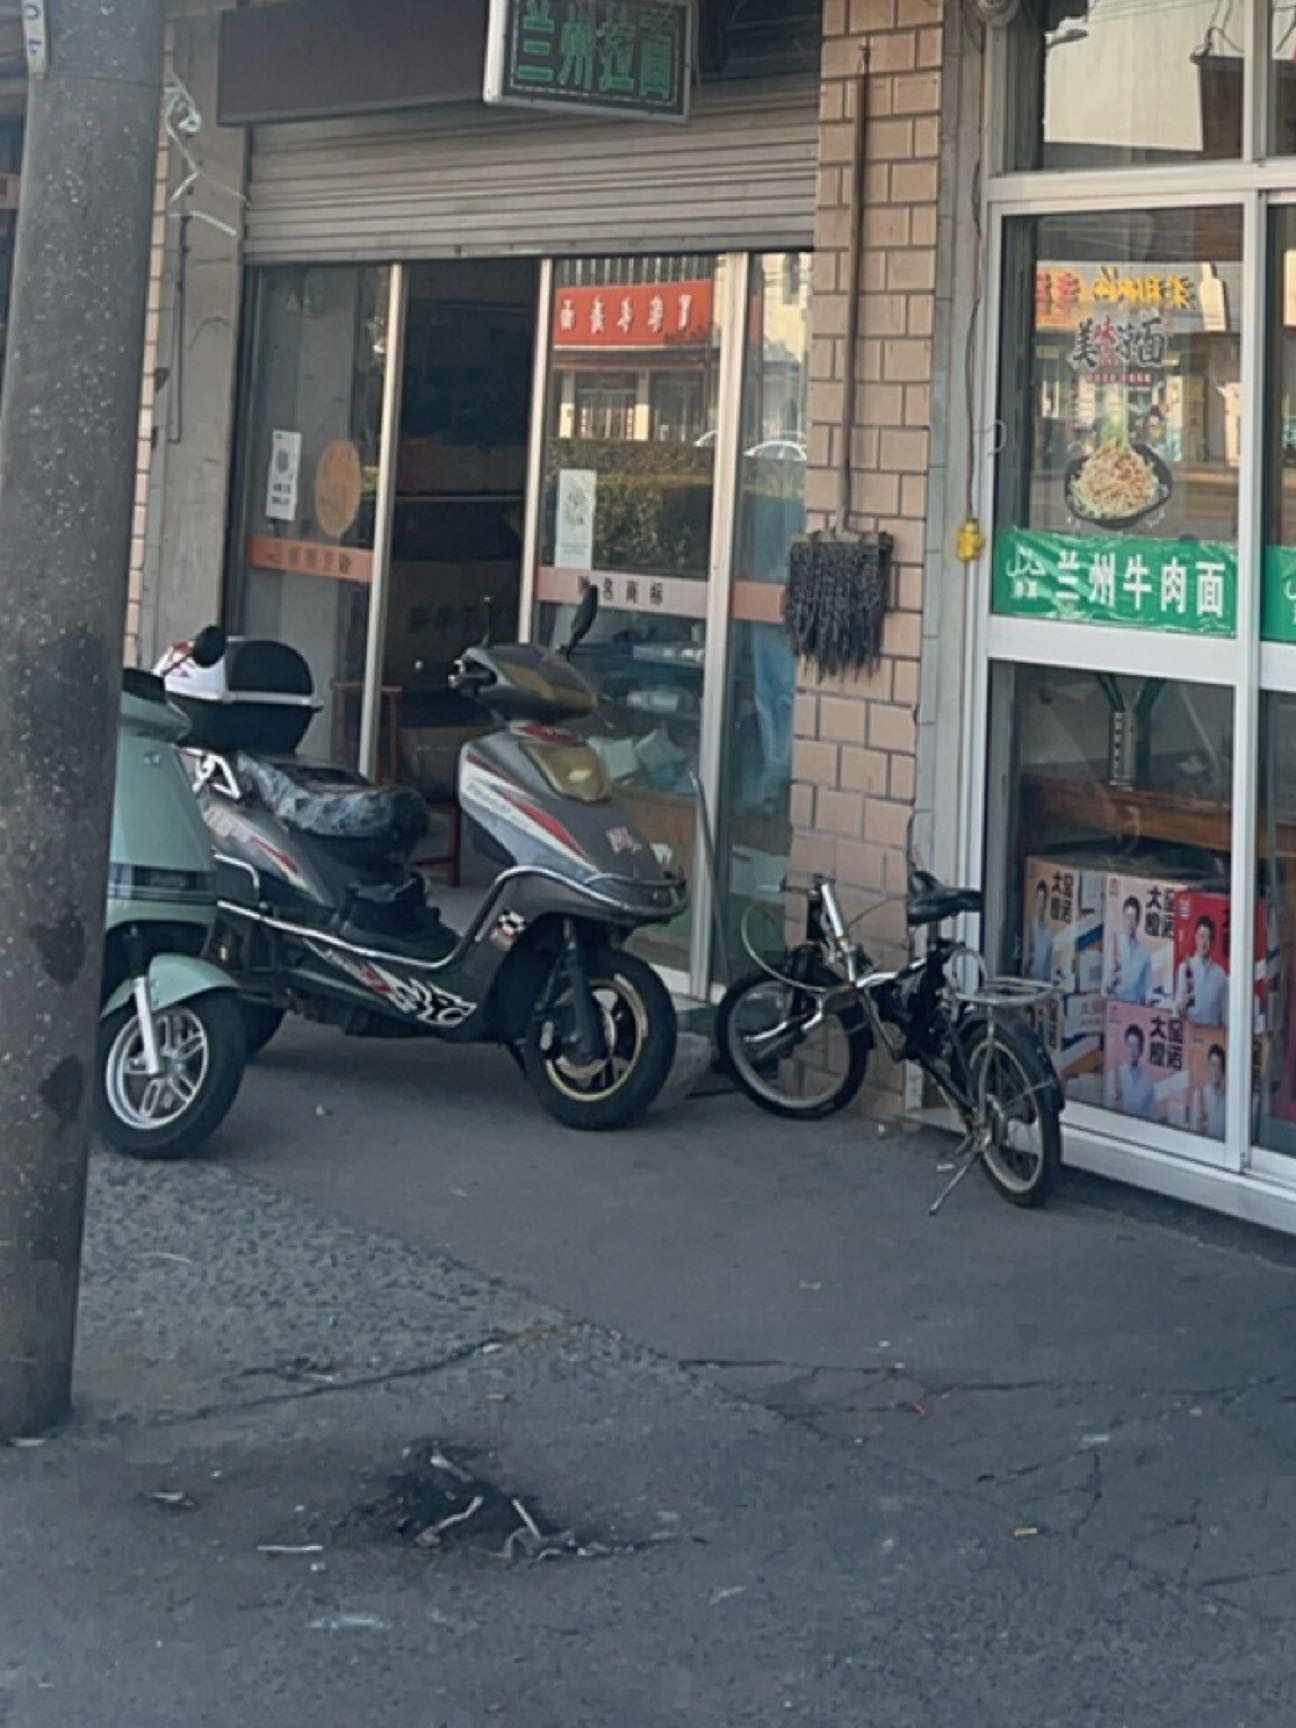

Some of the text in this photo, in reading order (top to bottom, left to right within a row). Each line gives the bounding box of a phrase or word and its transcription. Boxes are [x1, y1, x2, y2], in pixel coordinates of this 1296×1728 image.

[1055, 549, 1227, 618] 兰州牛肉面
